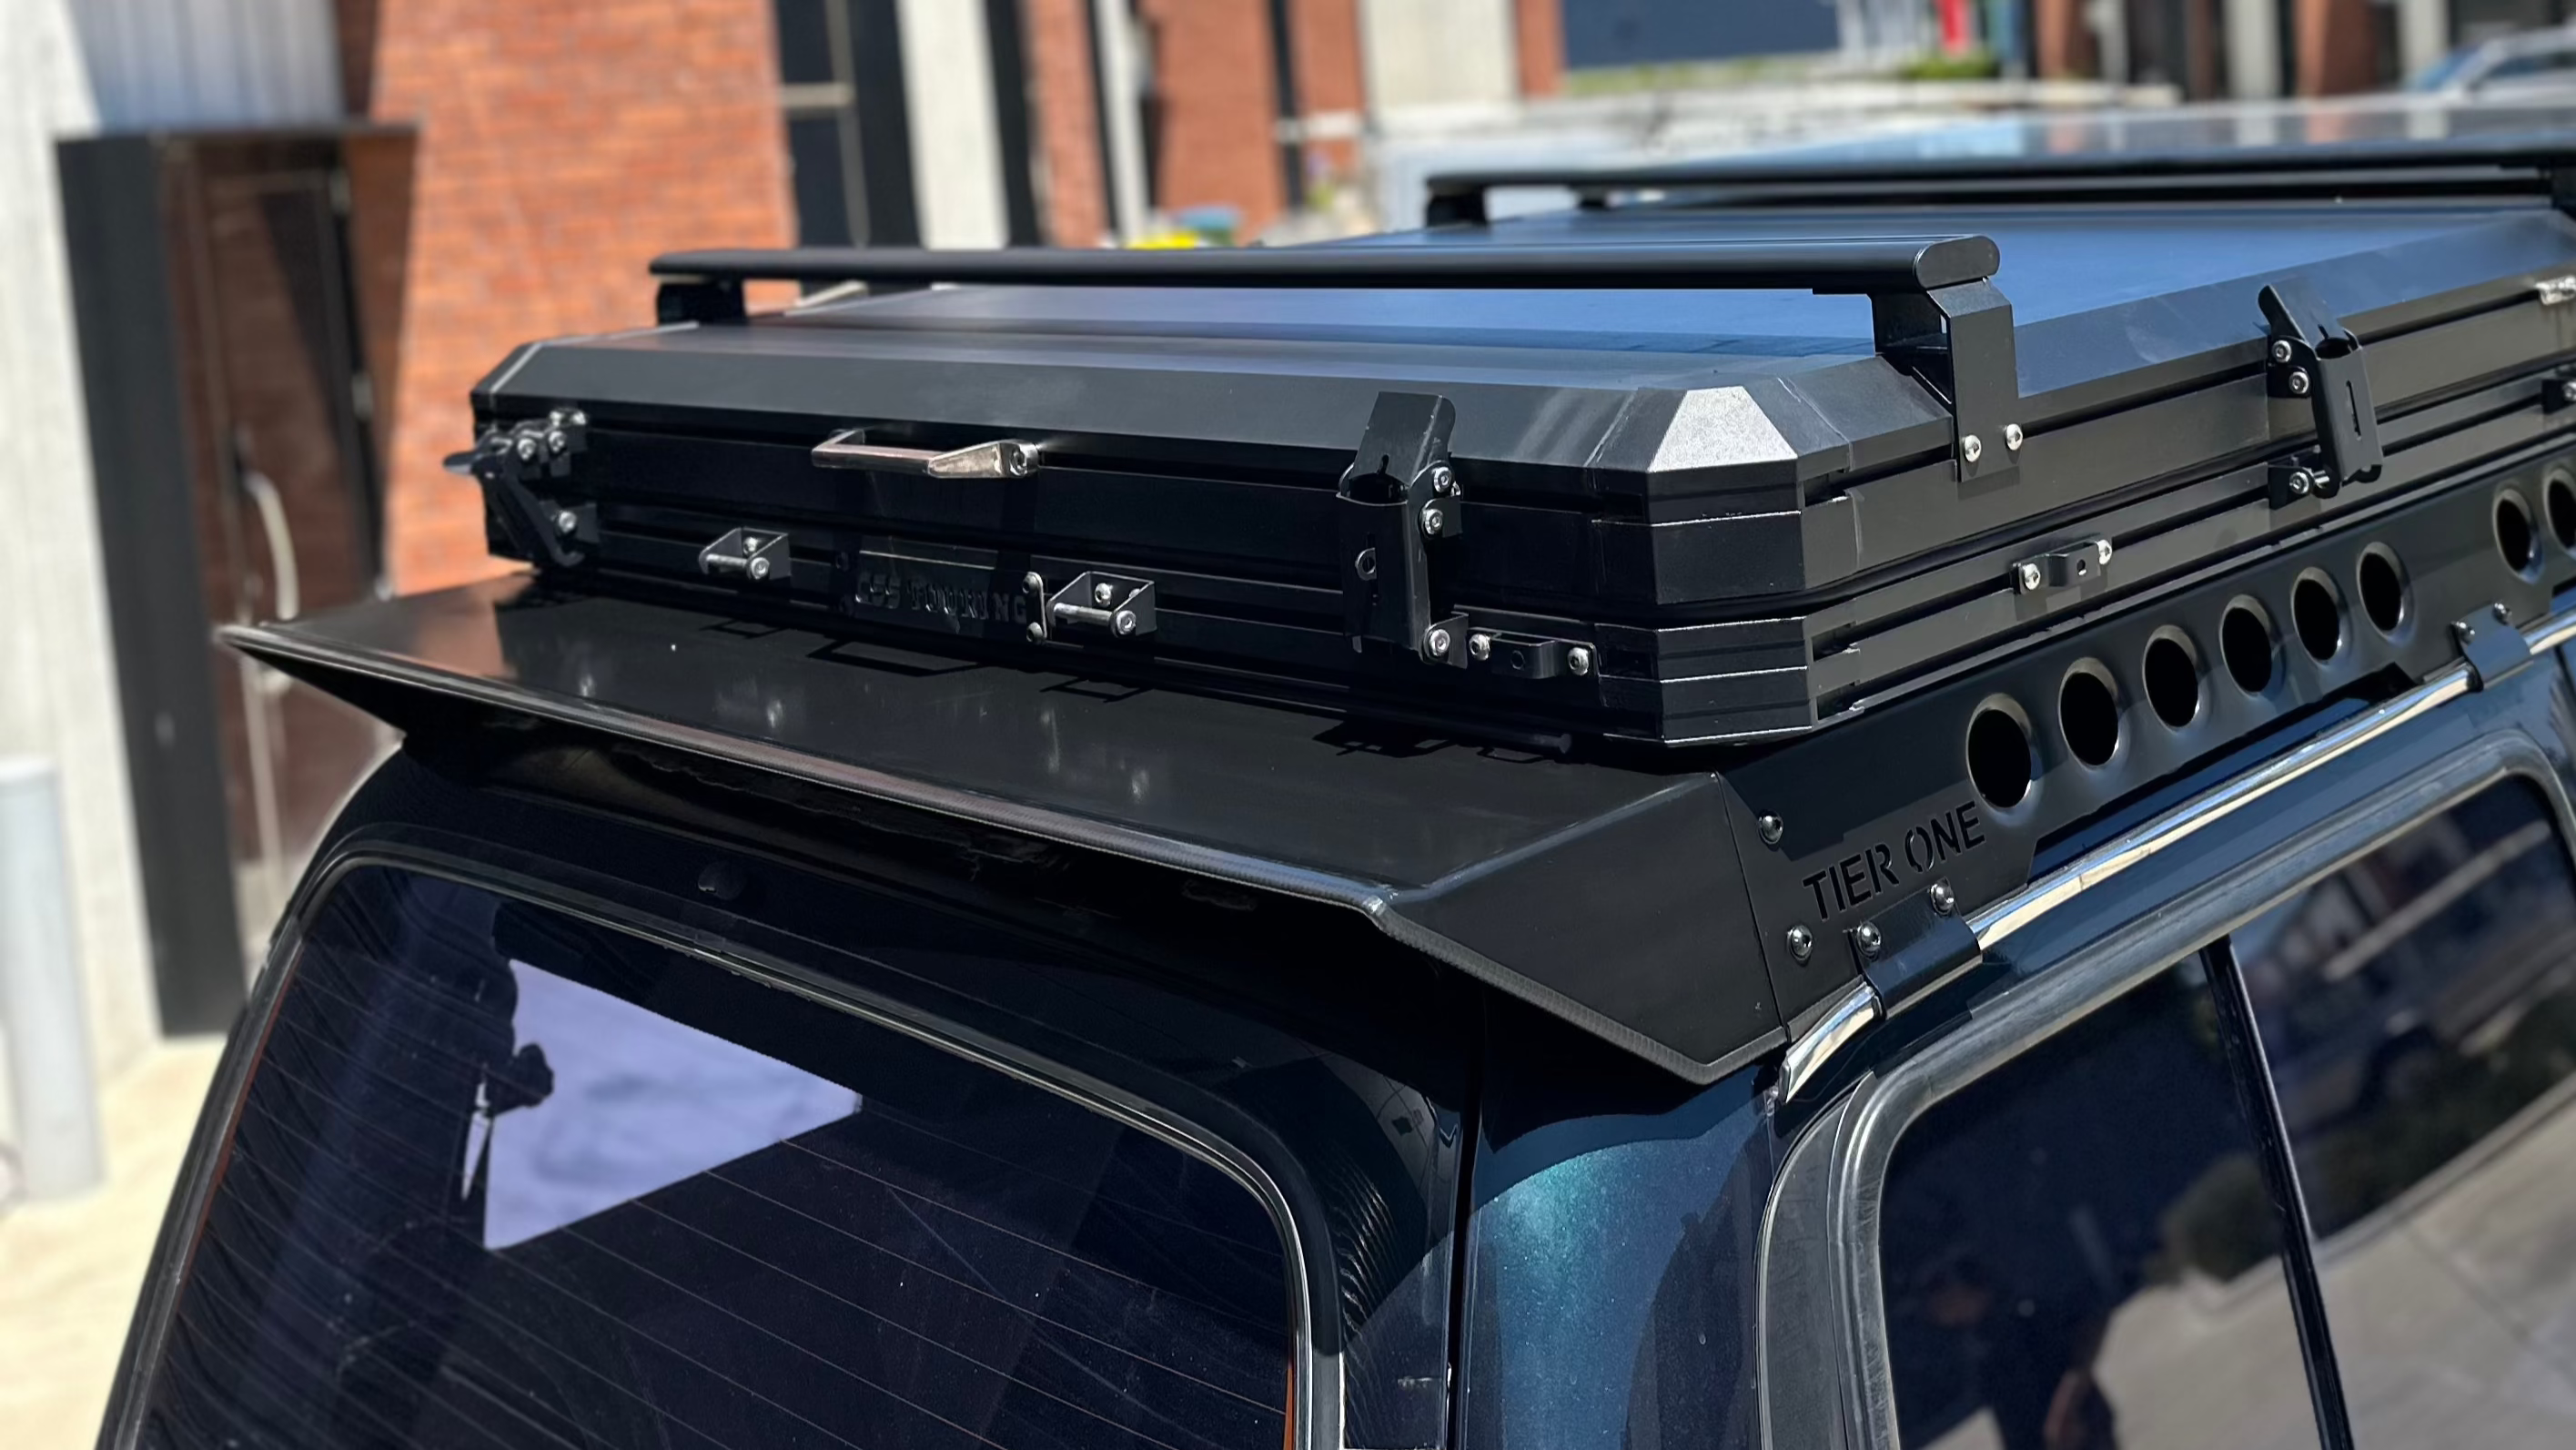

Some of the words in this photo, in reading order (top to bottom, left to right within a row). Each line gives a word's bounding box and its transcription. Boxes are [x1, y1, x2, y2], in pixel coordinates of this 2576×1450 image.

[906, 577, 1027, 624] TOURING
[1802, 839, 1900, 920] TIER
[1904, 800, 1986, 872] ONE
